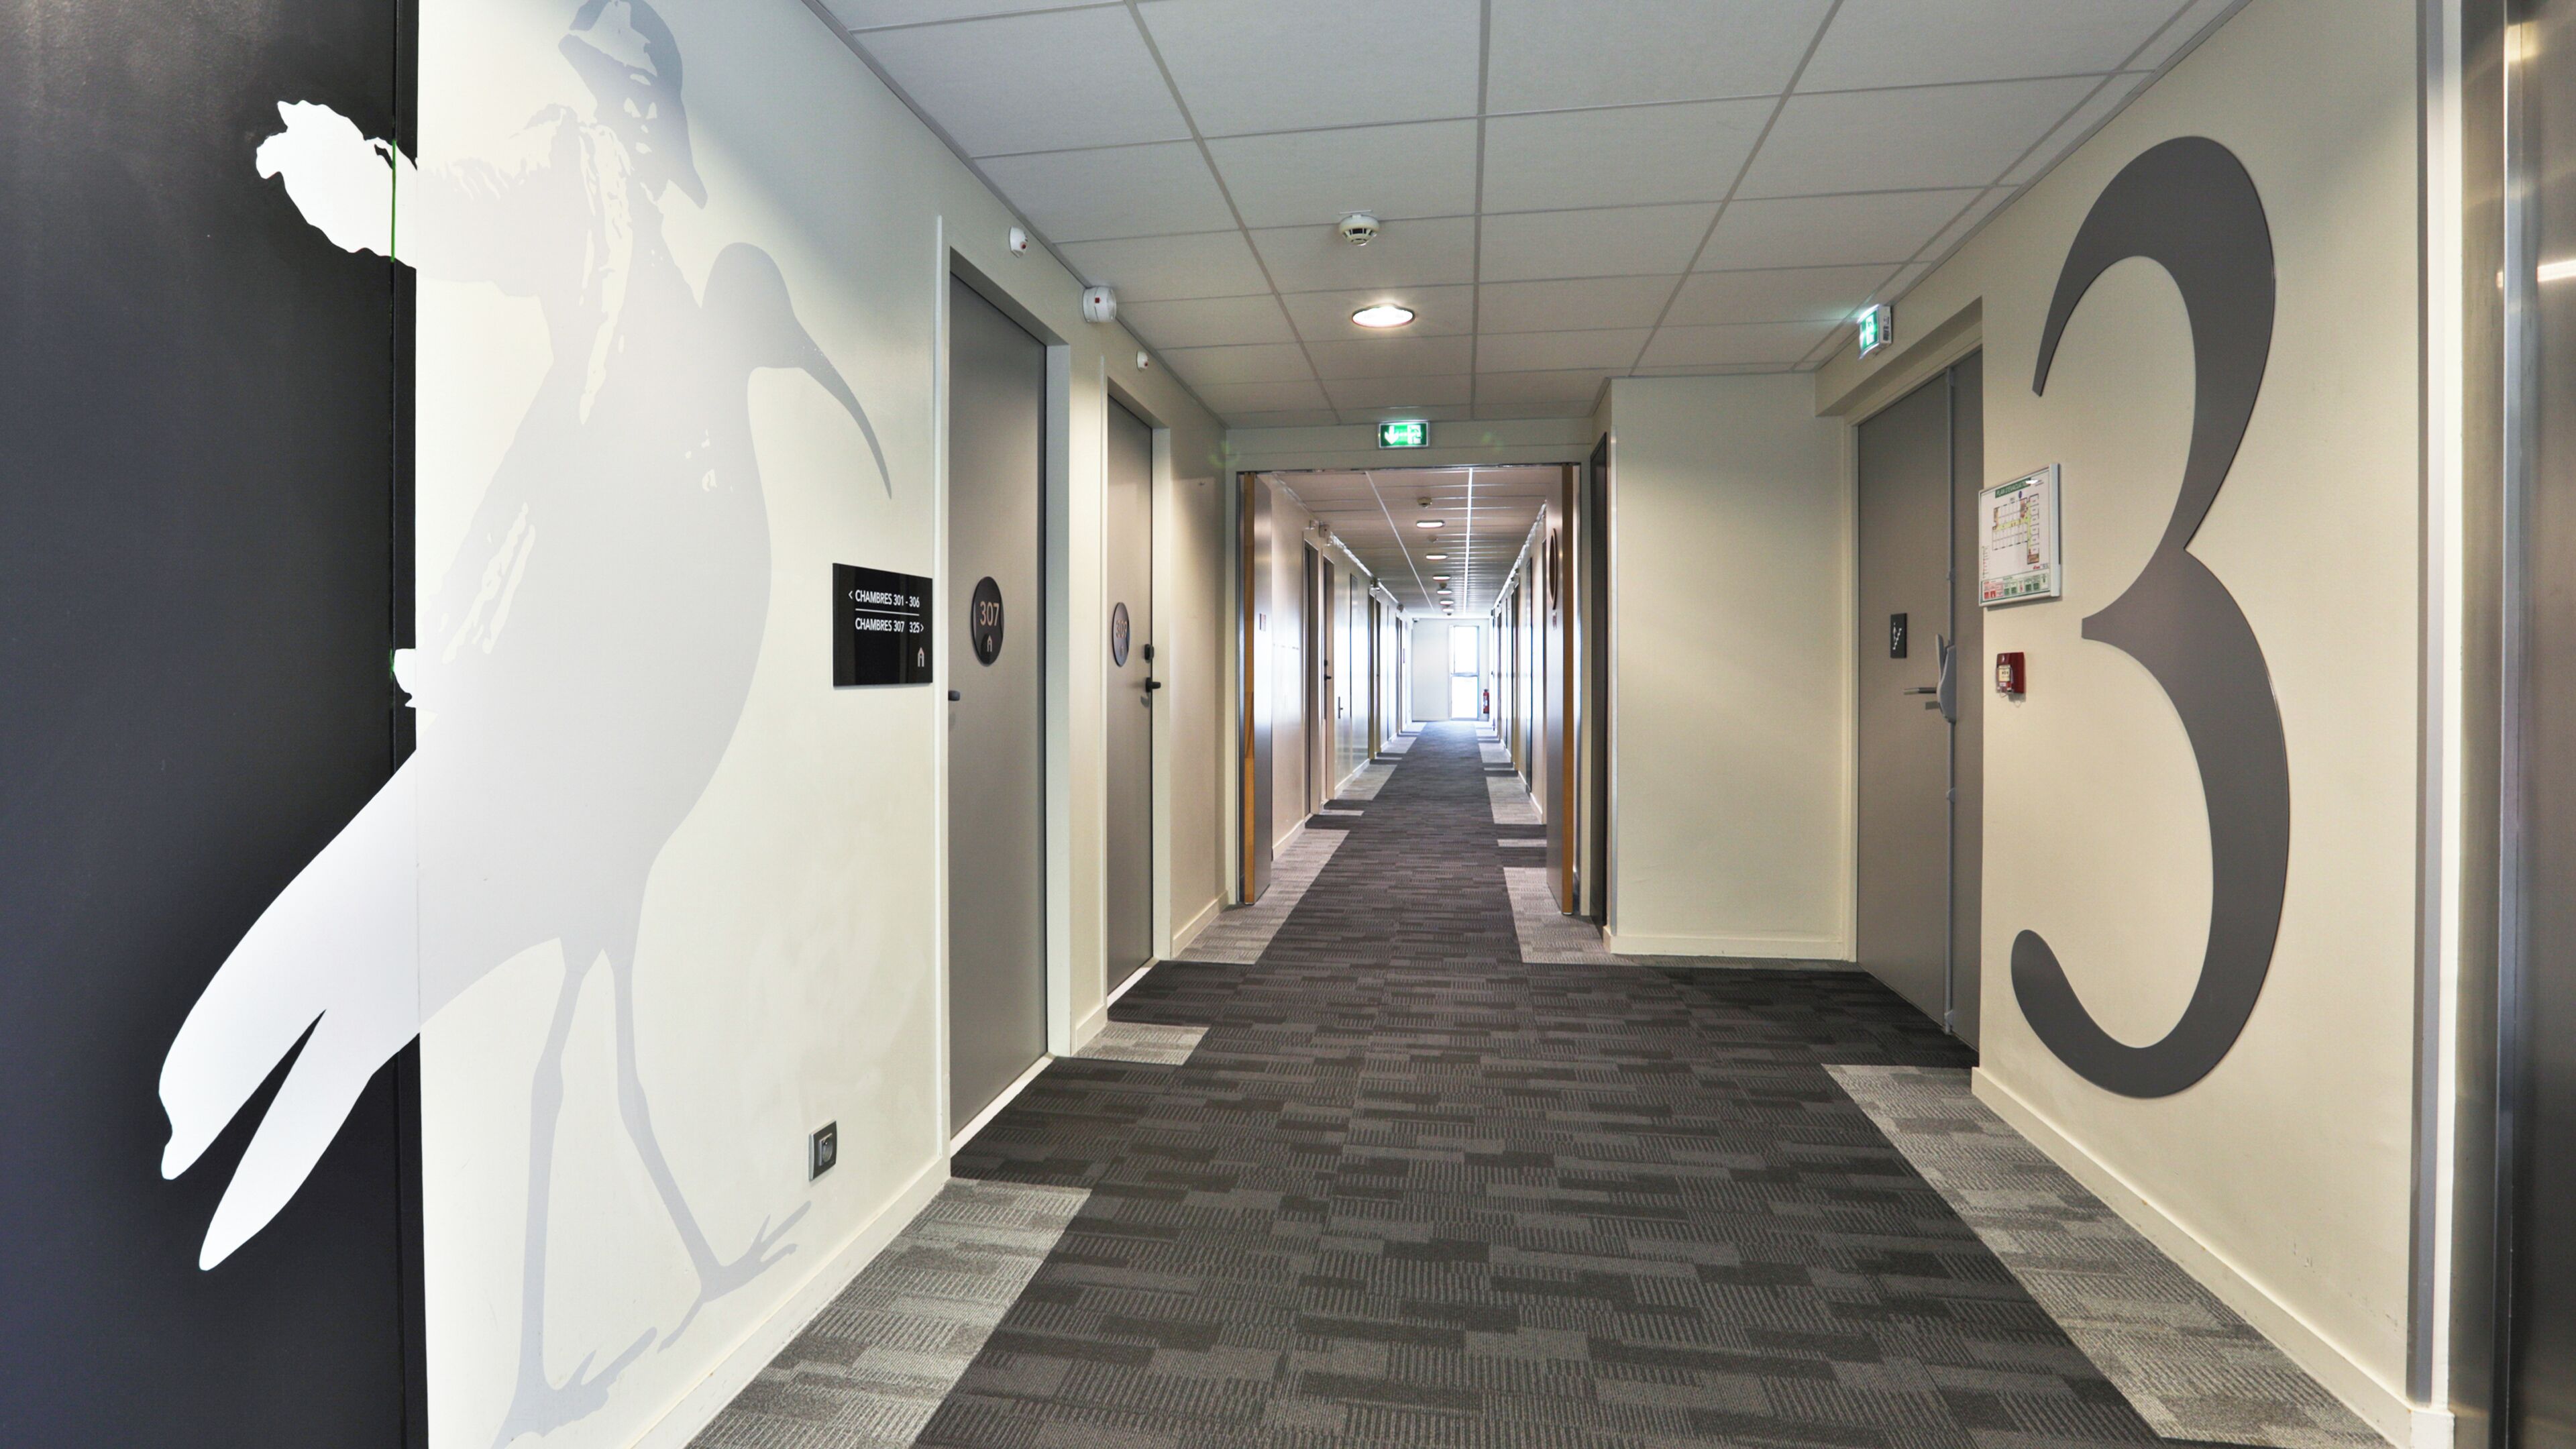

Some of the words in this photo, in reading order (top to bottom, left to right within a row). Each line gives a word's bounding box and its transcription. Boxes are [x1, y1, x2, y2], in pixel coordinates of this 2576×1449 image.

[855, 590, 892, 605] CHAMBRES
[894, 594, 904, 606] 301
[910, 596, 920, 608] 306
[979, 601, 1000, 626] 307
[2011, 136, 2290, 1099] 3
[855, 617, 892, 632] CHAMBRES
[894, 621, 904, 633] 307
[909, 622, 920, 633] 325
